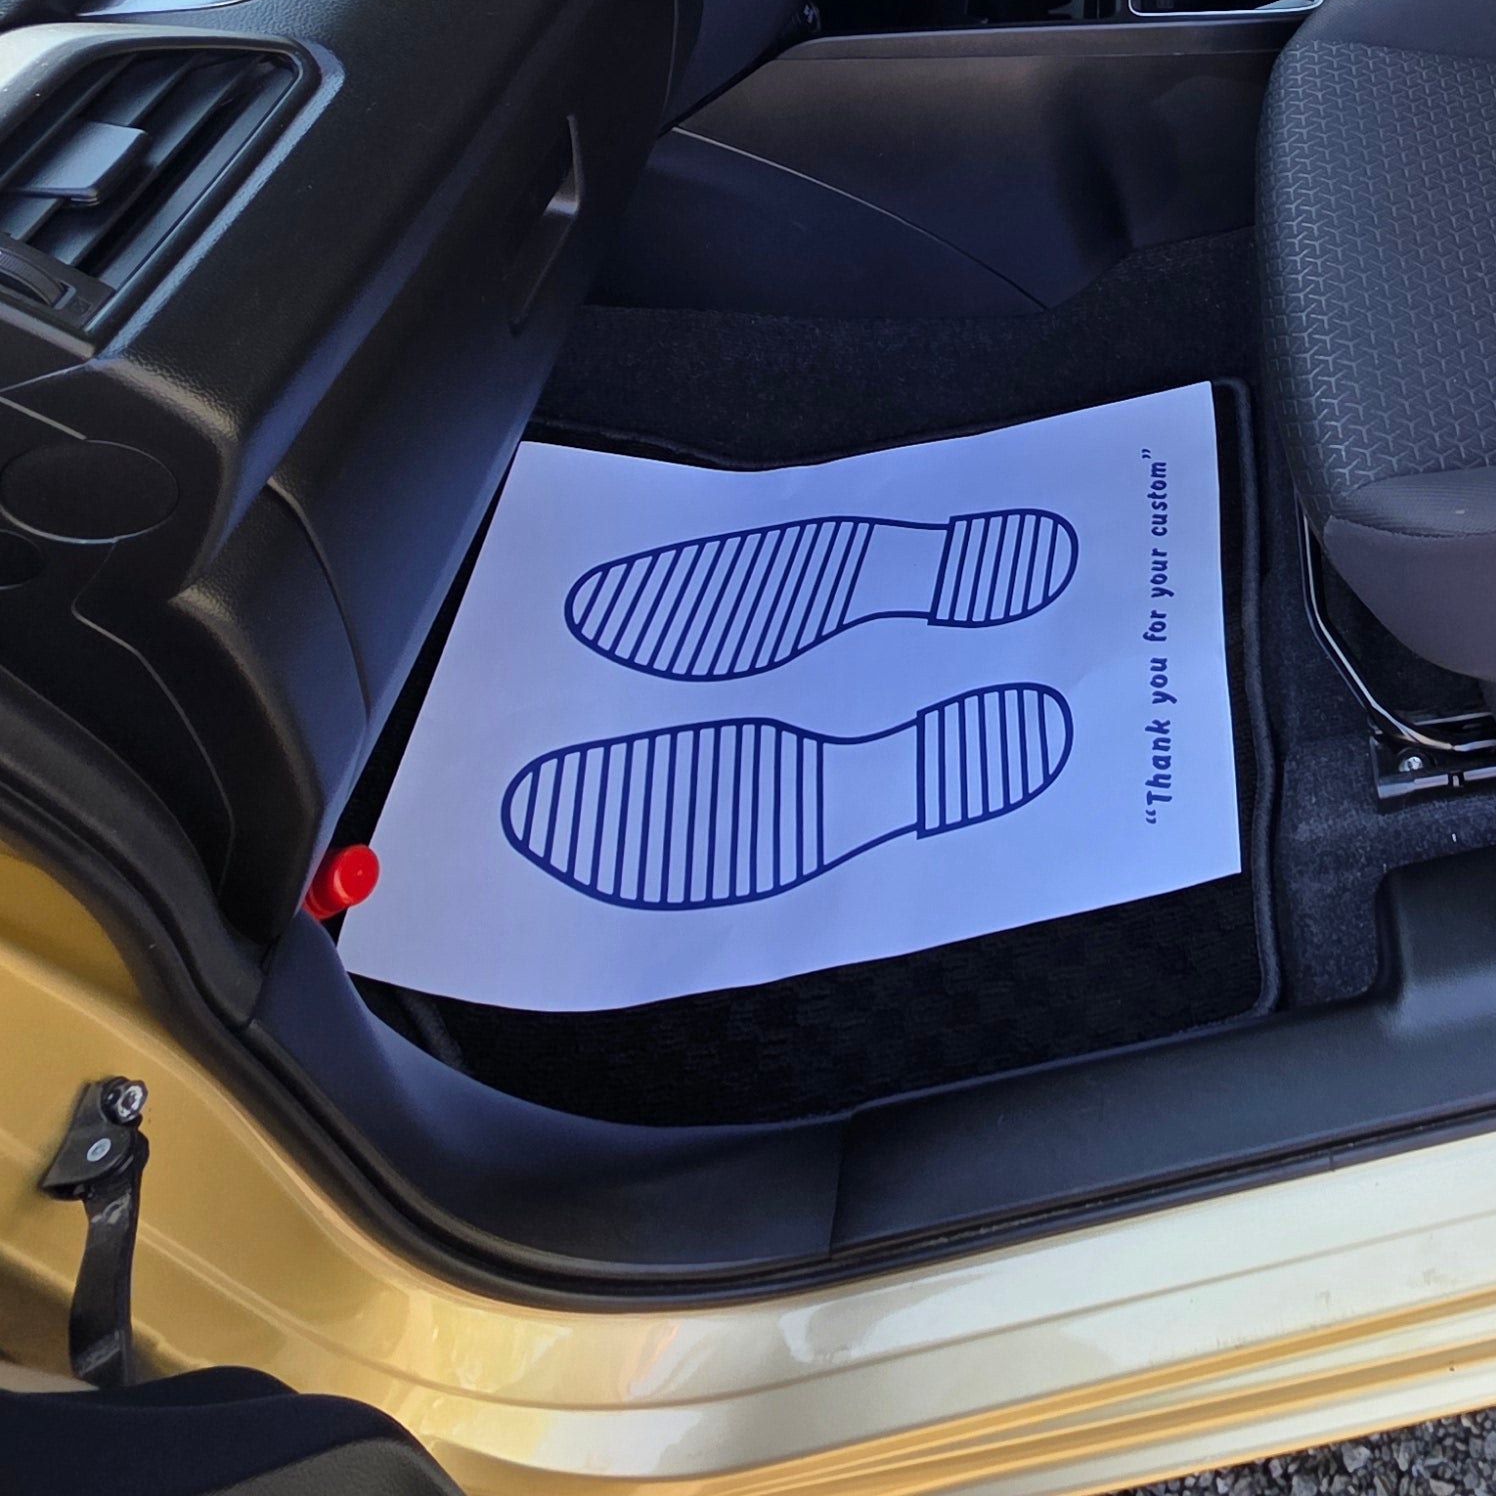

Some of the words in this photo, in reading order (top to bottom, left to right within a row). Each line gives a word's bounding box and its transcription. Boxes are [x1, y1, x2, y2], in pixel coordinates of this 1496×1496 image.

[1150, 548, 1174, 599] your
[1142, 609, 1168, 642] for
[1150, 656, 1178, 704] you
